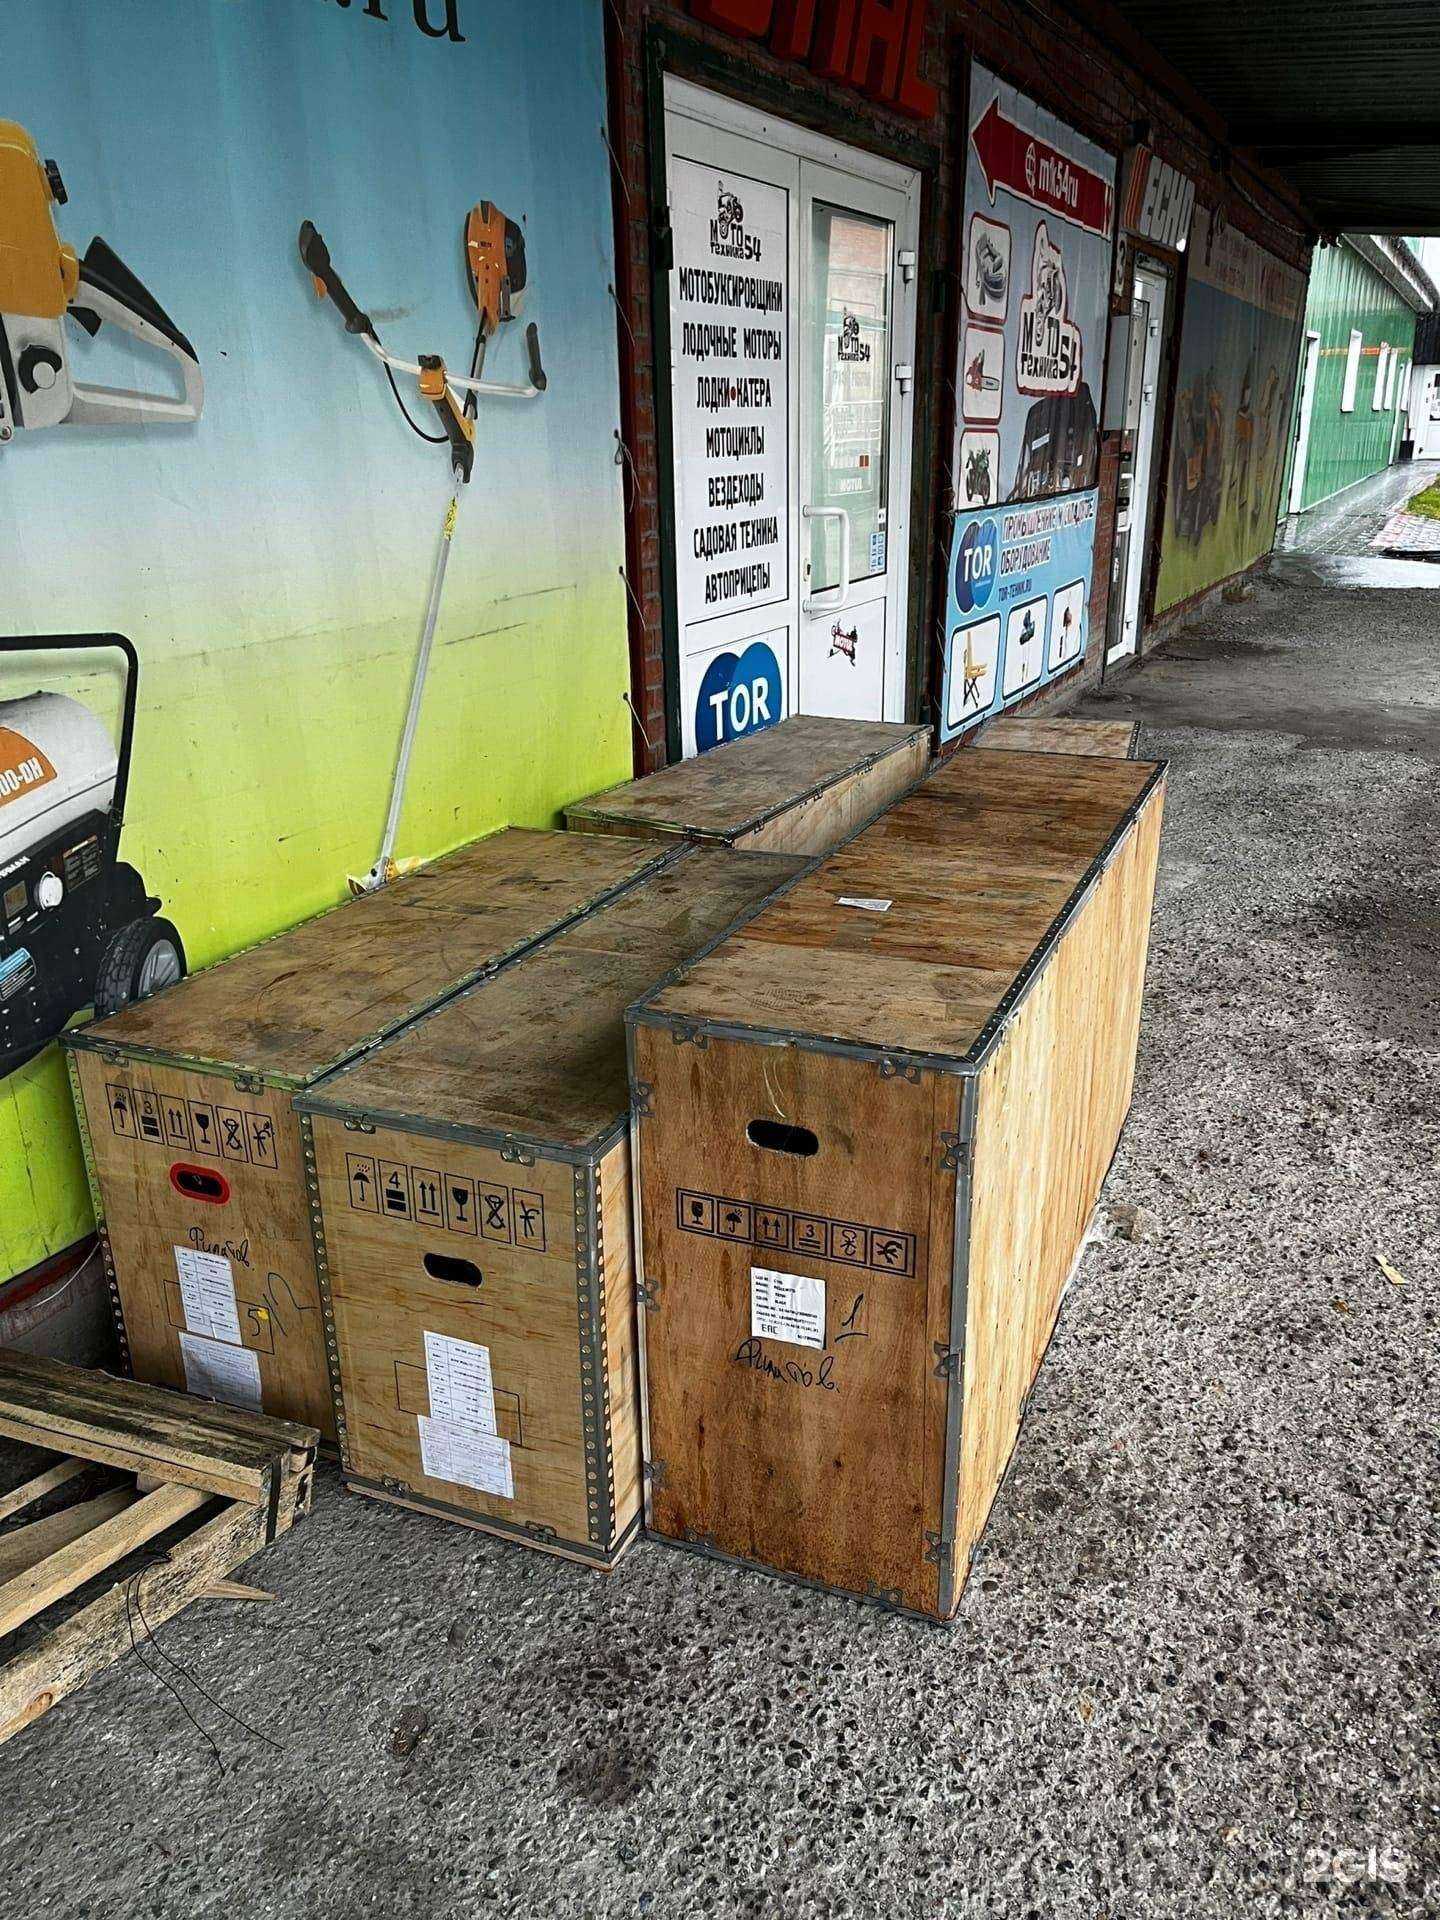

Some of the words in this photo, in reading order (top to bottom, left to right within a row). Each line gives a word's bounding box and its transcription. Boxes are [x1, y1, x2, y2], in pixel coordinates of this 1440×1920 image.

[744, 234, 762, 262] 54
[679, 266, 783, 315] МОТОБУКСИРОВЩИКИ
[682, 322, 737, 362] ЛОДОЧНЫЕ
[743, 327, 782, 360] МОТОРЫ
[696, 376, 730, 413] ЛОДКИ
[736, 378, 772, 407] КАТЕРА
[706, 426, 765, 461] МОТОЦИКЛЫ
[708, 472, 764, 510] ВЕЗДЕХОДЫ
[693, 522, 737, 561] САДОВАЯ
[740, 516, 779, 550] ТЕХНИКА
[963, 545, 992, 582] TOR
[705, 562, 770, 605] АВТОПРИЦЕПЫ
[709, 676, 772, 740] TOR
[388, 1171, 401, 1189] 4
[804, 1223, 816, 1238] 3
